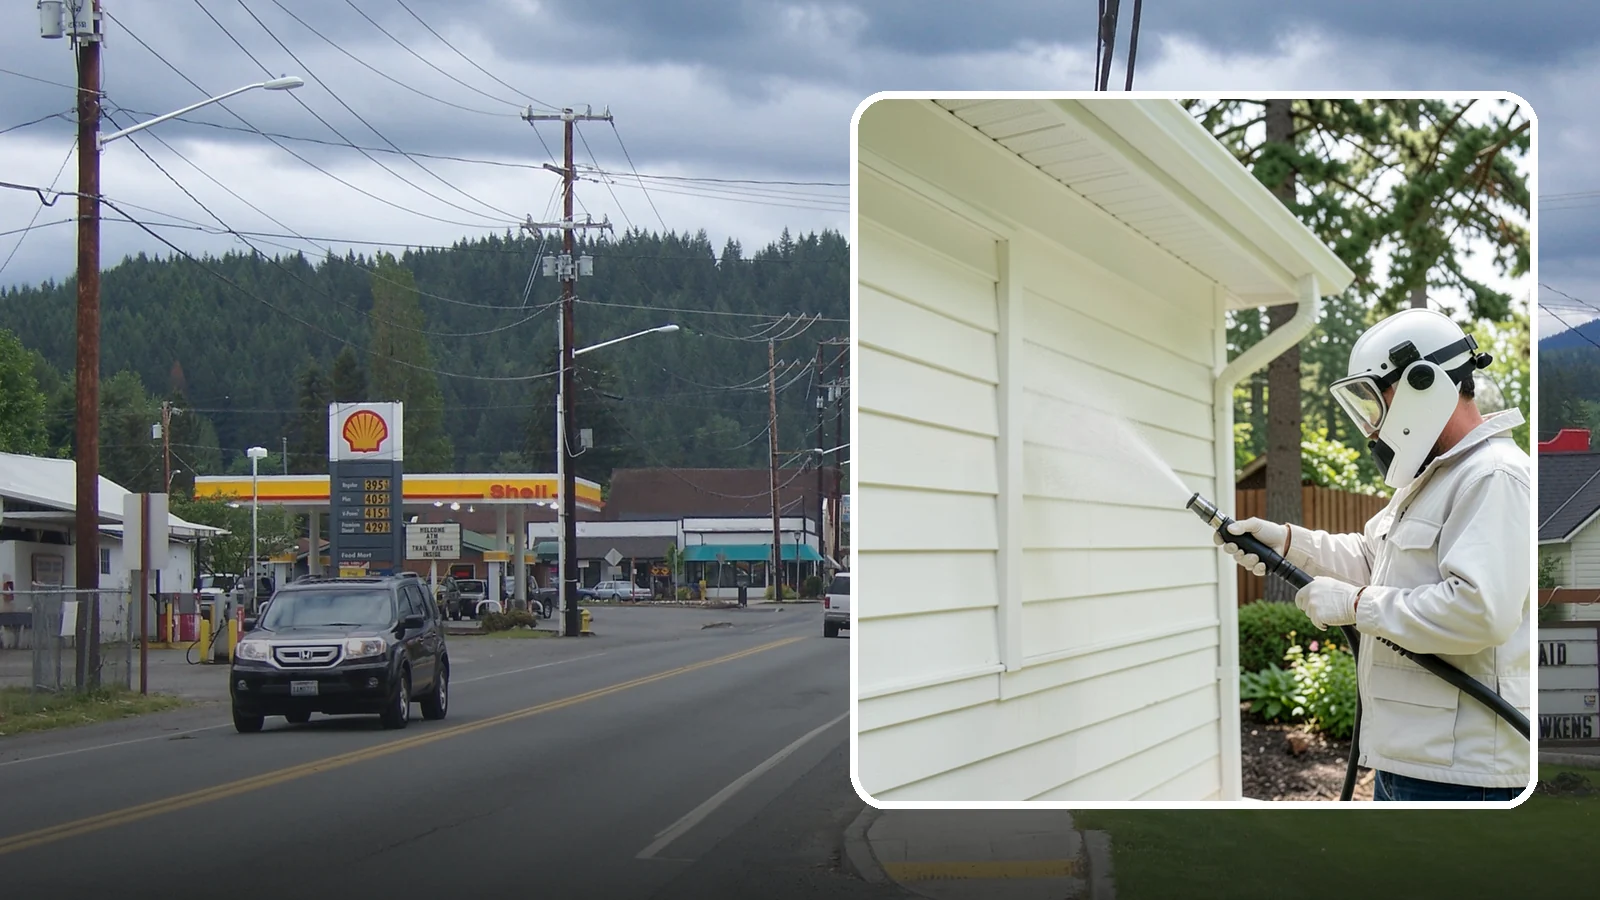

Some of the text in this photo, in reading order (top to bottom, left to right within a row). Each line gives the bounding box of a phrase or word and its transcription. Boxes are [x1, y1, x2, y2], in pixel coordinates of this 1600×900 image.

[366, 480, 384, 490] 395
[490, 484, 548, 499] Shell
[366, 494, 384, 504] 405
[366, 508, 384, 518] 415
[366, 522, 384, 532] 429
[1538, 642, 1567, 666] AID
[1538, 715, 1592, 739] WKENS
